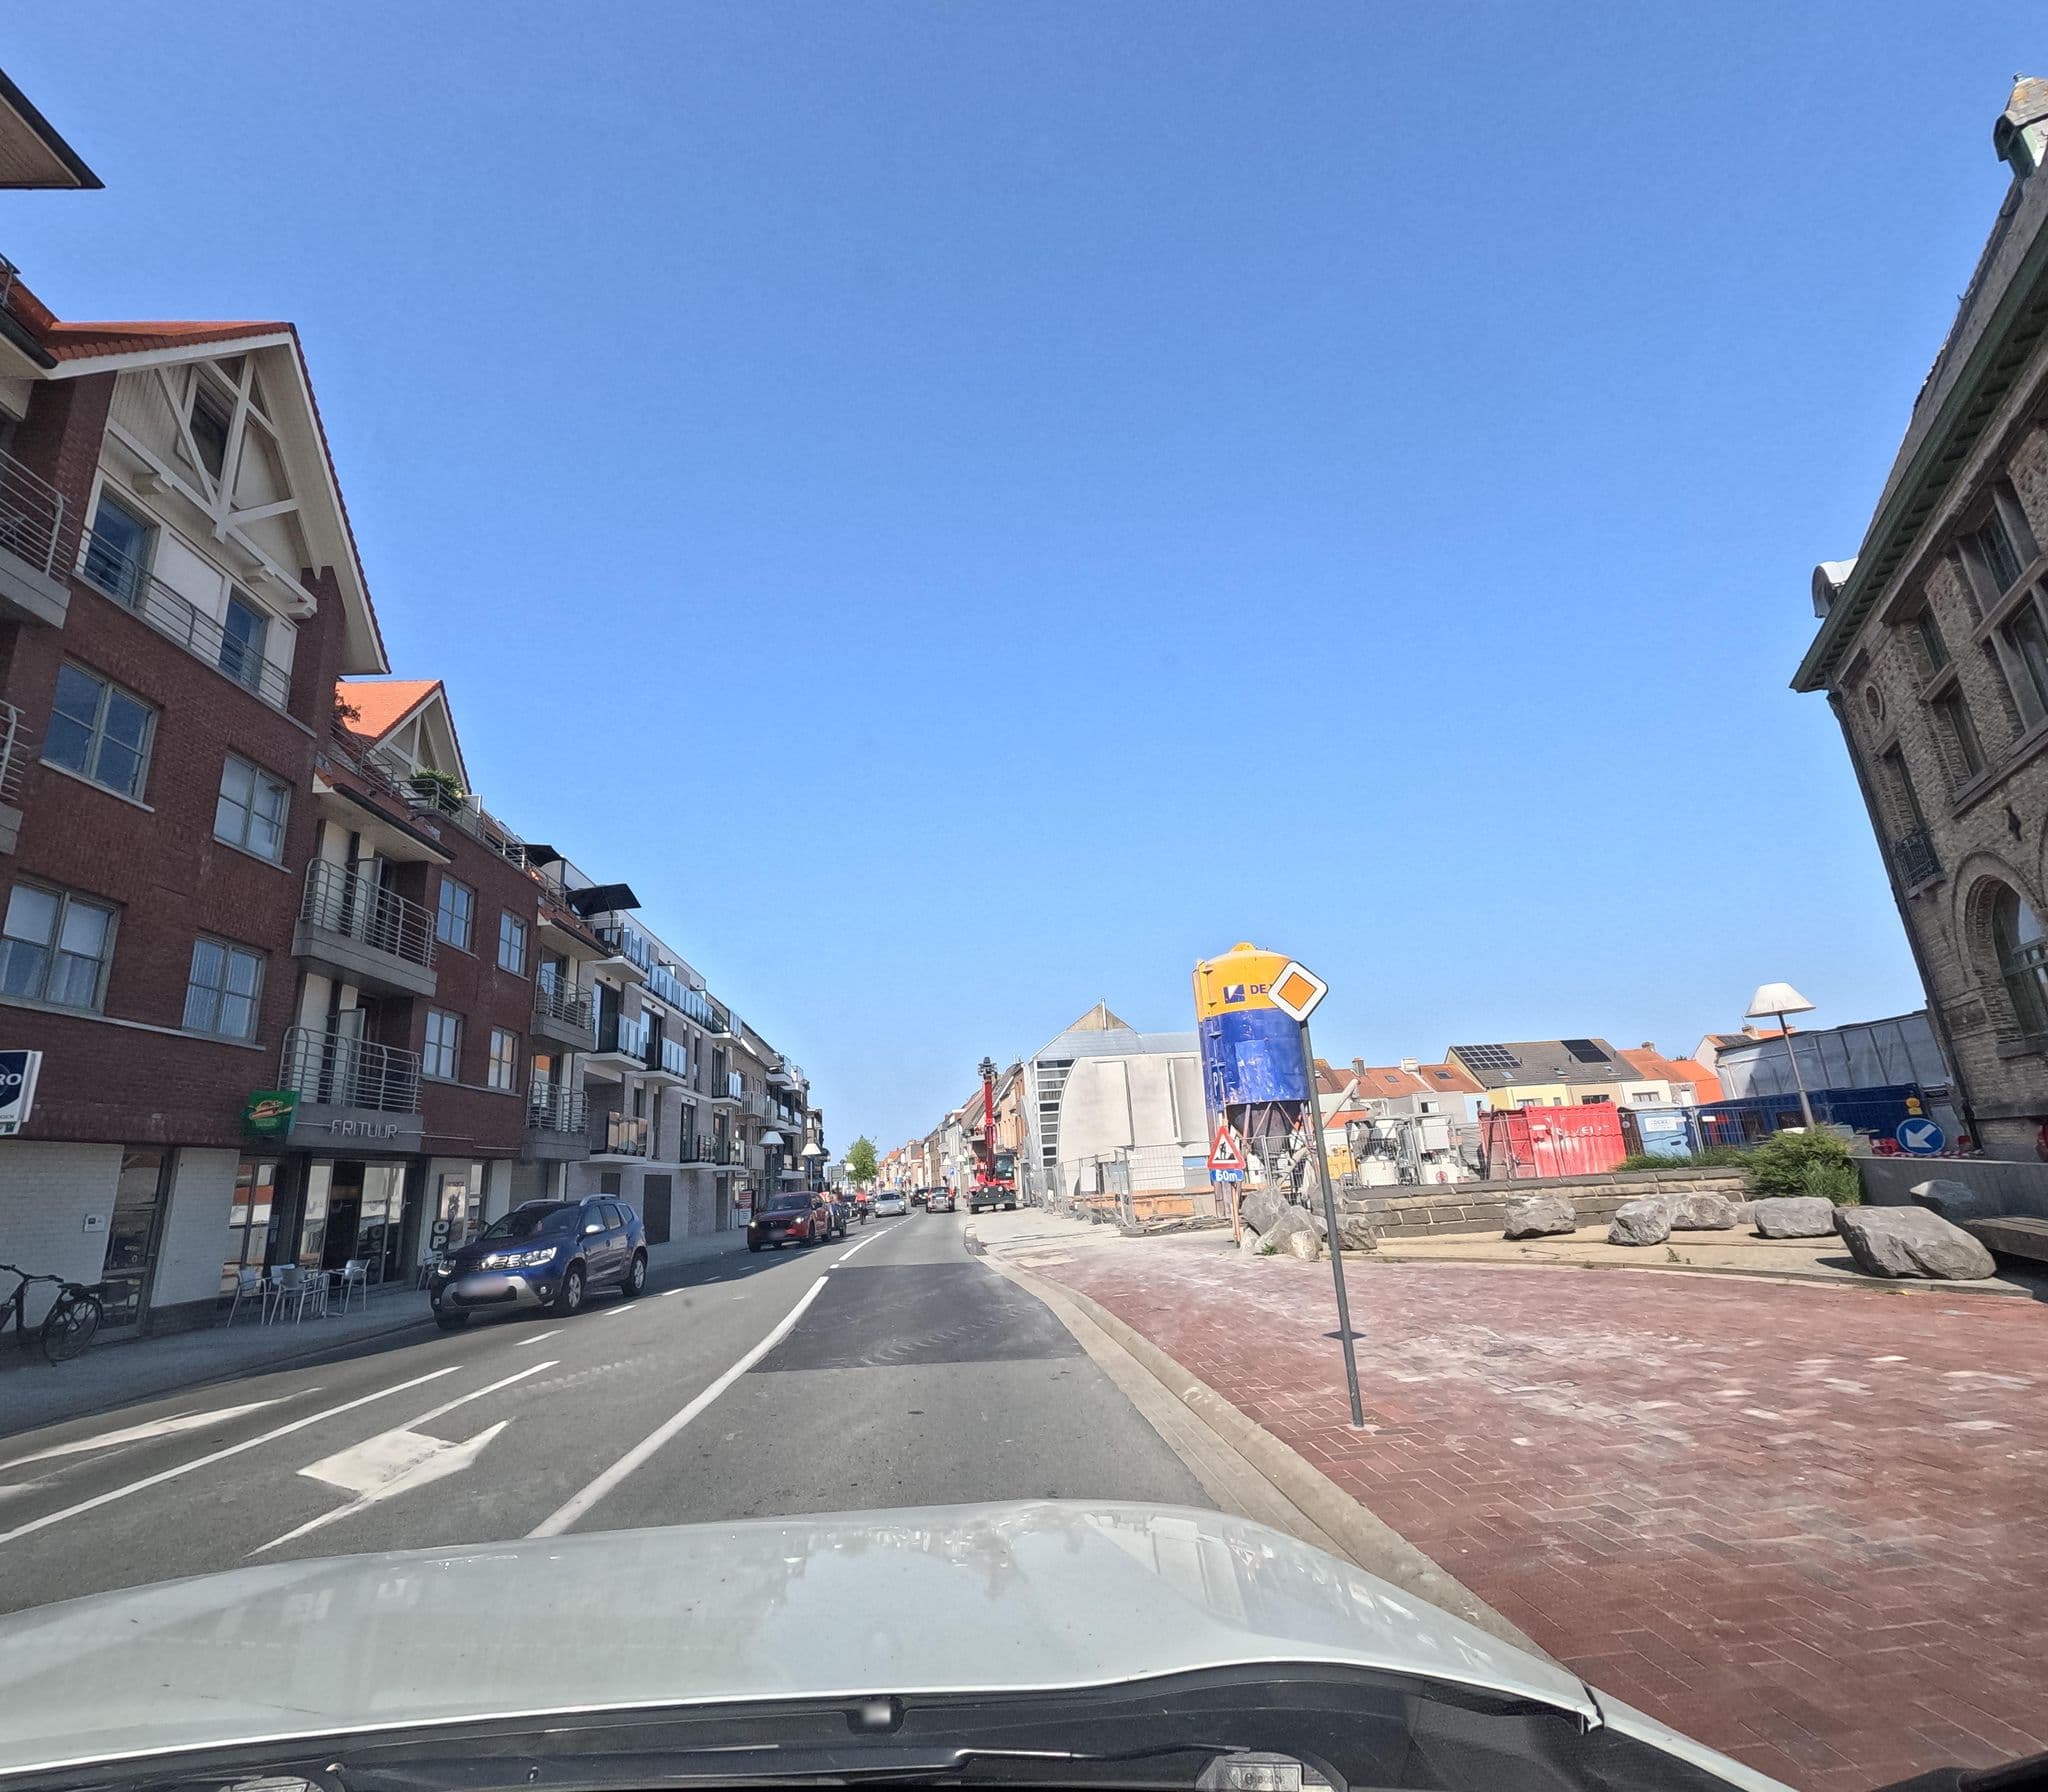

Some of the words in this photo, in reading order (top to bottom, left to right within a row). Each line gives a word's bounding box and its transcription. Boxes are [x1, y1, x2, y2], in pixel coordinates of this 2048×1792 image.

[331, 1119, 398, 1138] FRITUUR
[1215, 1170, 1238, 1181] 50m
[432, 1221, 449, 1264] OPE
